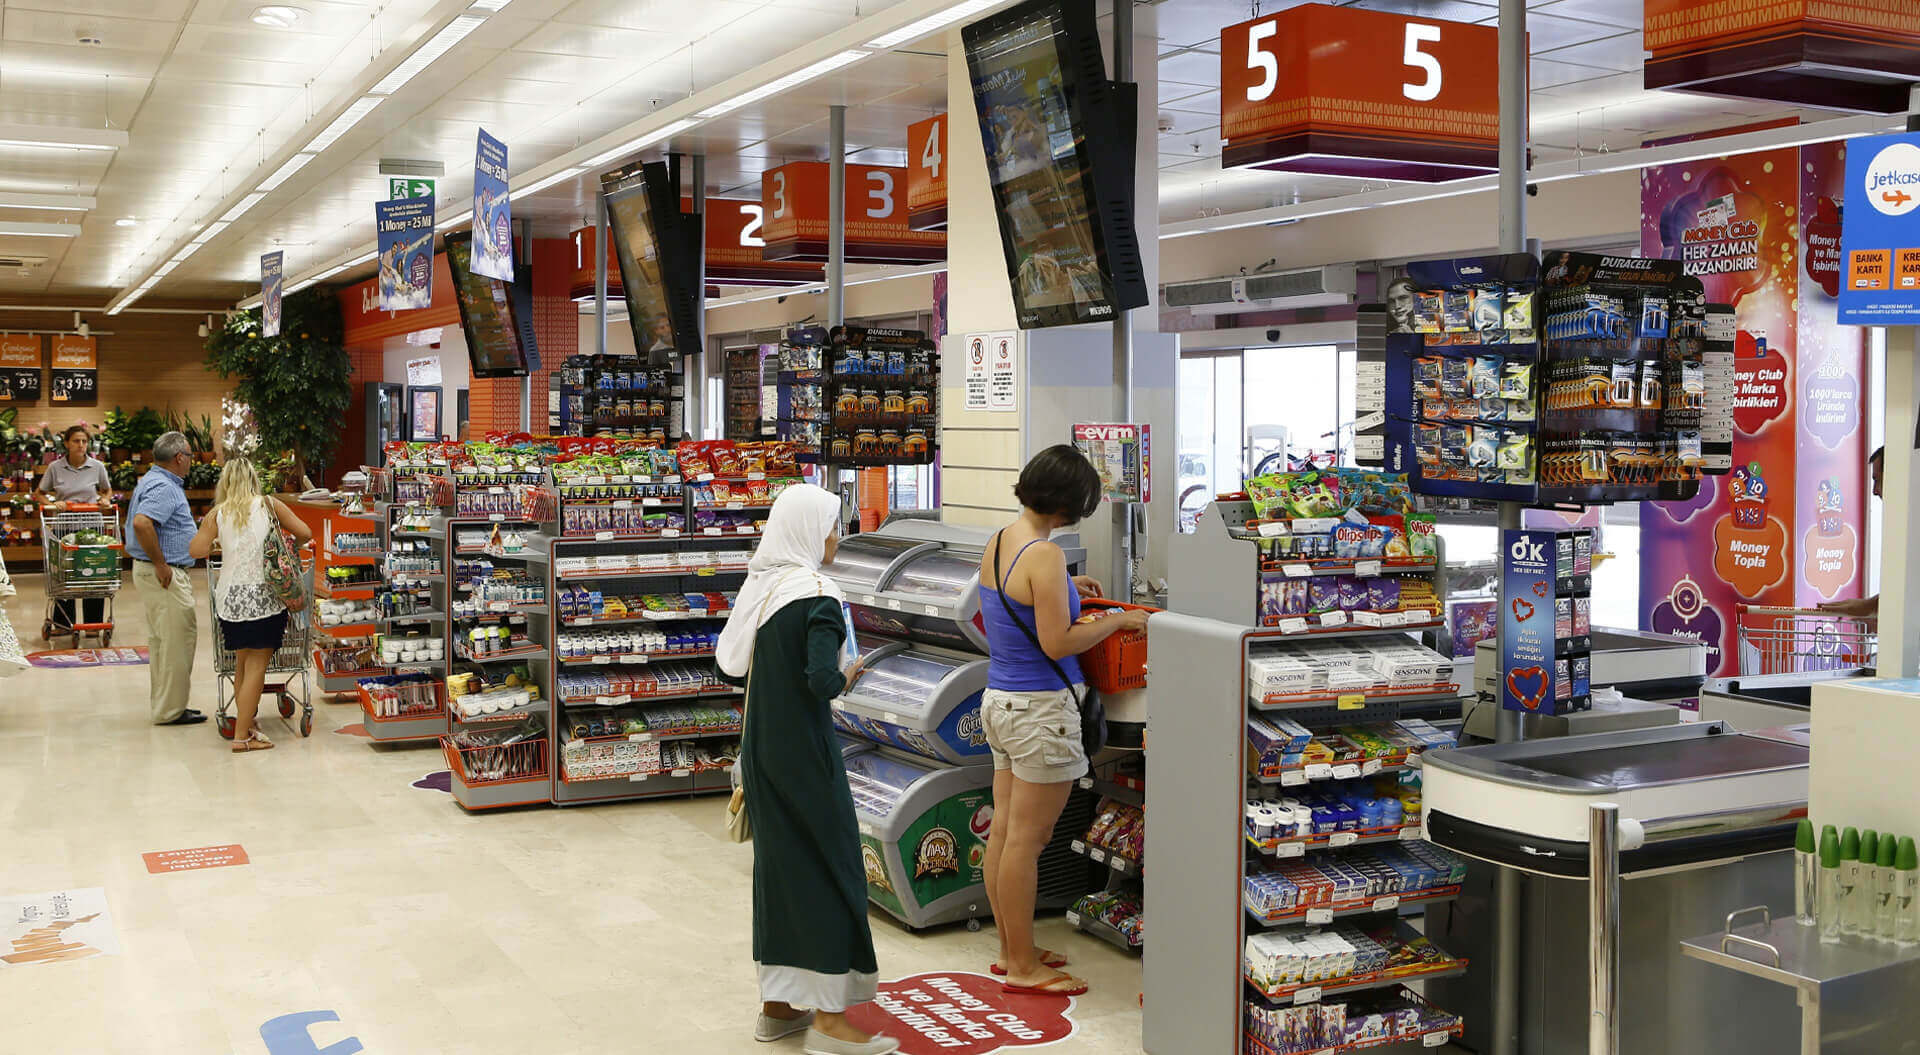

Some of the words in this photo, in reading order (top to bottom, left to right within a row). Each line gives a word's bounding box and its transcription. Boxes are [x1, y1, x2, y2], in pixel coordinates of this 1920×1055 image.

[1247, 20, 1278, 101] 5
[1403, 22, 1442, 101] 5
[922, 121, 941, 177] 4
[1871, 167, 1920, 191] jetkas
[773, 172, 785, 219] 3
[866, 171, 894, 218] 3
[380, 221, 384, 232] 1
[386, 220, 406, 232] Money
[412, 217, 421, 228] 25
[740, 205, 766, 247] 2
[1682, 225, 1728, 243] MONEY
[1730, 220, 1759, 238] Club
[1810, 235, 1837, 247] Money
[575, 232, 583, 269] 1
[1683, 246, 1709, 260] HER
[1711, 241, 1758, 258] ZAMAN
[1600, 257, 1652, 269] DURACELL
[1856, 254, 1883, 263] BANKA
[1683, 258, 1758, 276] KAZANDIRIR!
[1856, 265, 1882, 274] KARTI
[1758, 369, 1783, 380] Club
[1741, 383, 1776, 394] Marka
[1085, 427, 1133, 440] evim
[1337, 528, 1362, 543] Olips
[1411, 520, 1435, 536] Olips
[1730, 540, 1770, 556] Money
[1816, 548, 1845, 560] Money
[1734, 554, 1766, 568] Topla
[1819, 560, 1842, 572] Topla
[1326, 659, 1351, 667] SODYNE
[1266, 674, 1305, 682] SENSODYNE
[1393, 668, 1432, 677] SENSODYNE
[927, 844, 946, 857] MAX
[901, 988, 933, 1002] ve
[923, 1003, 995, 1039] Marka
[922, 977, 997, 1011] Money
[986, 1013, 1044, 1040] Club
